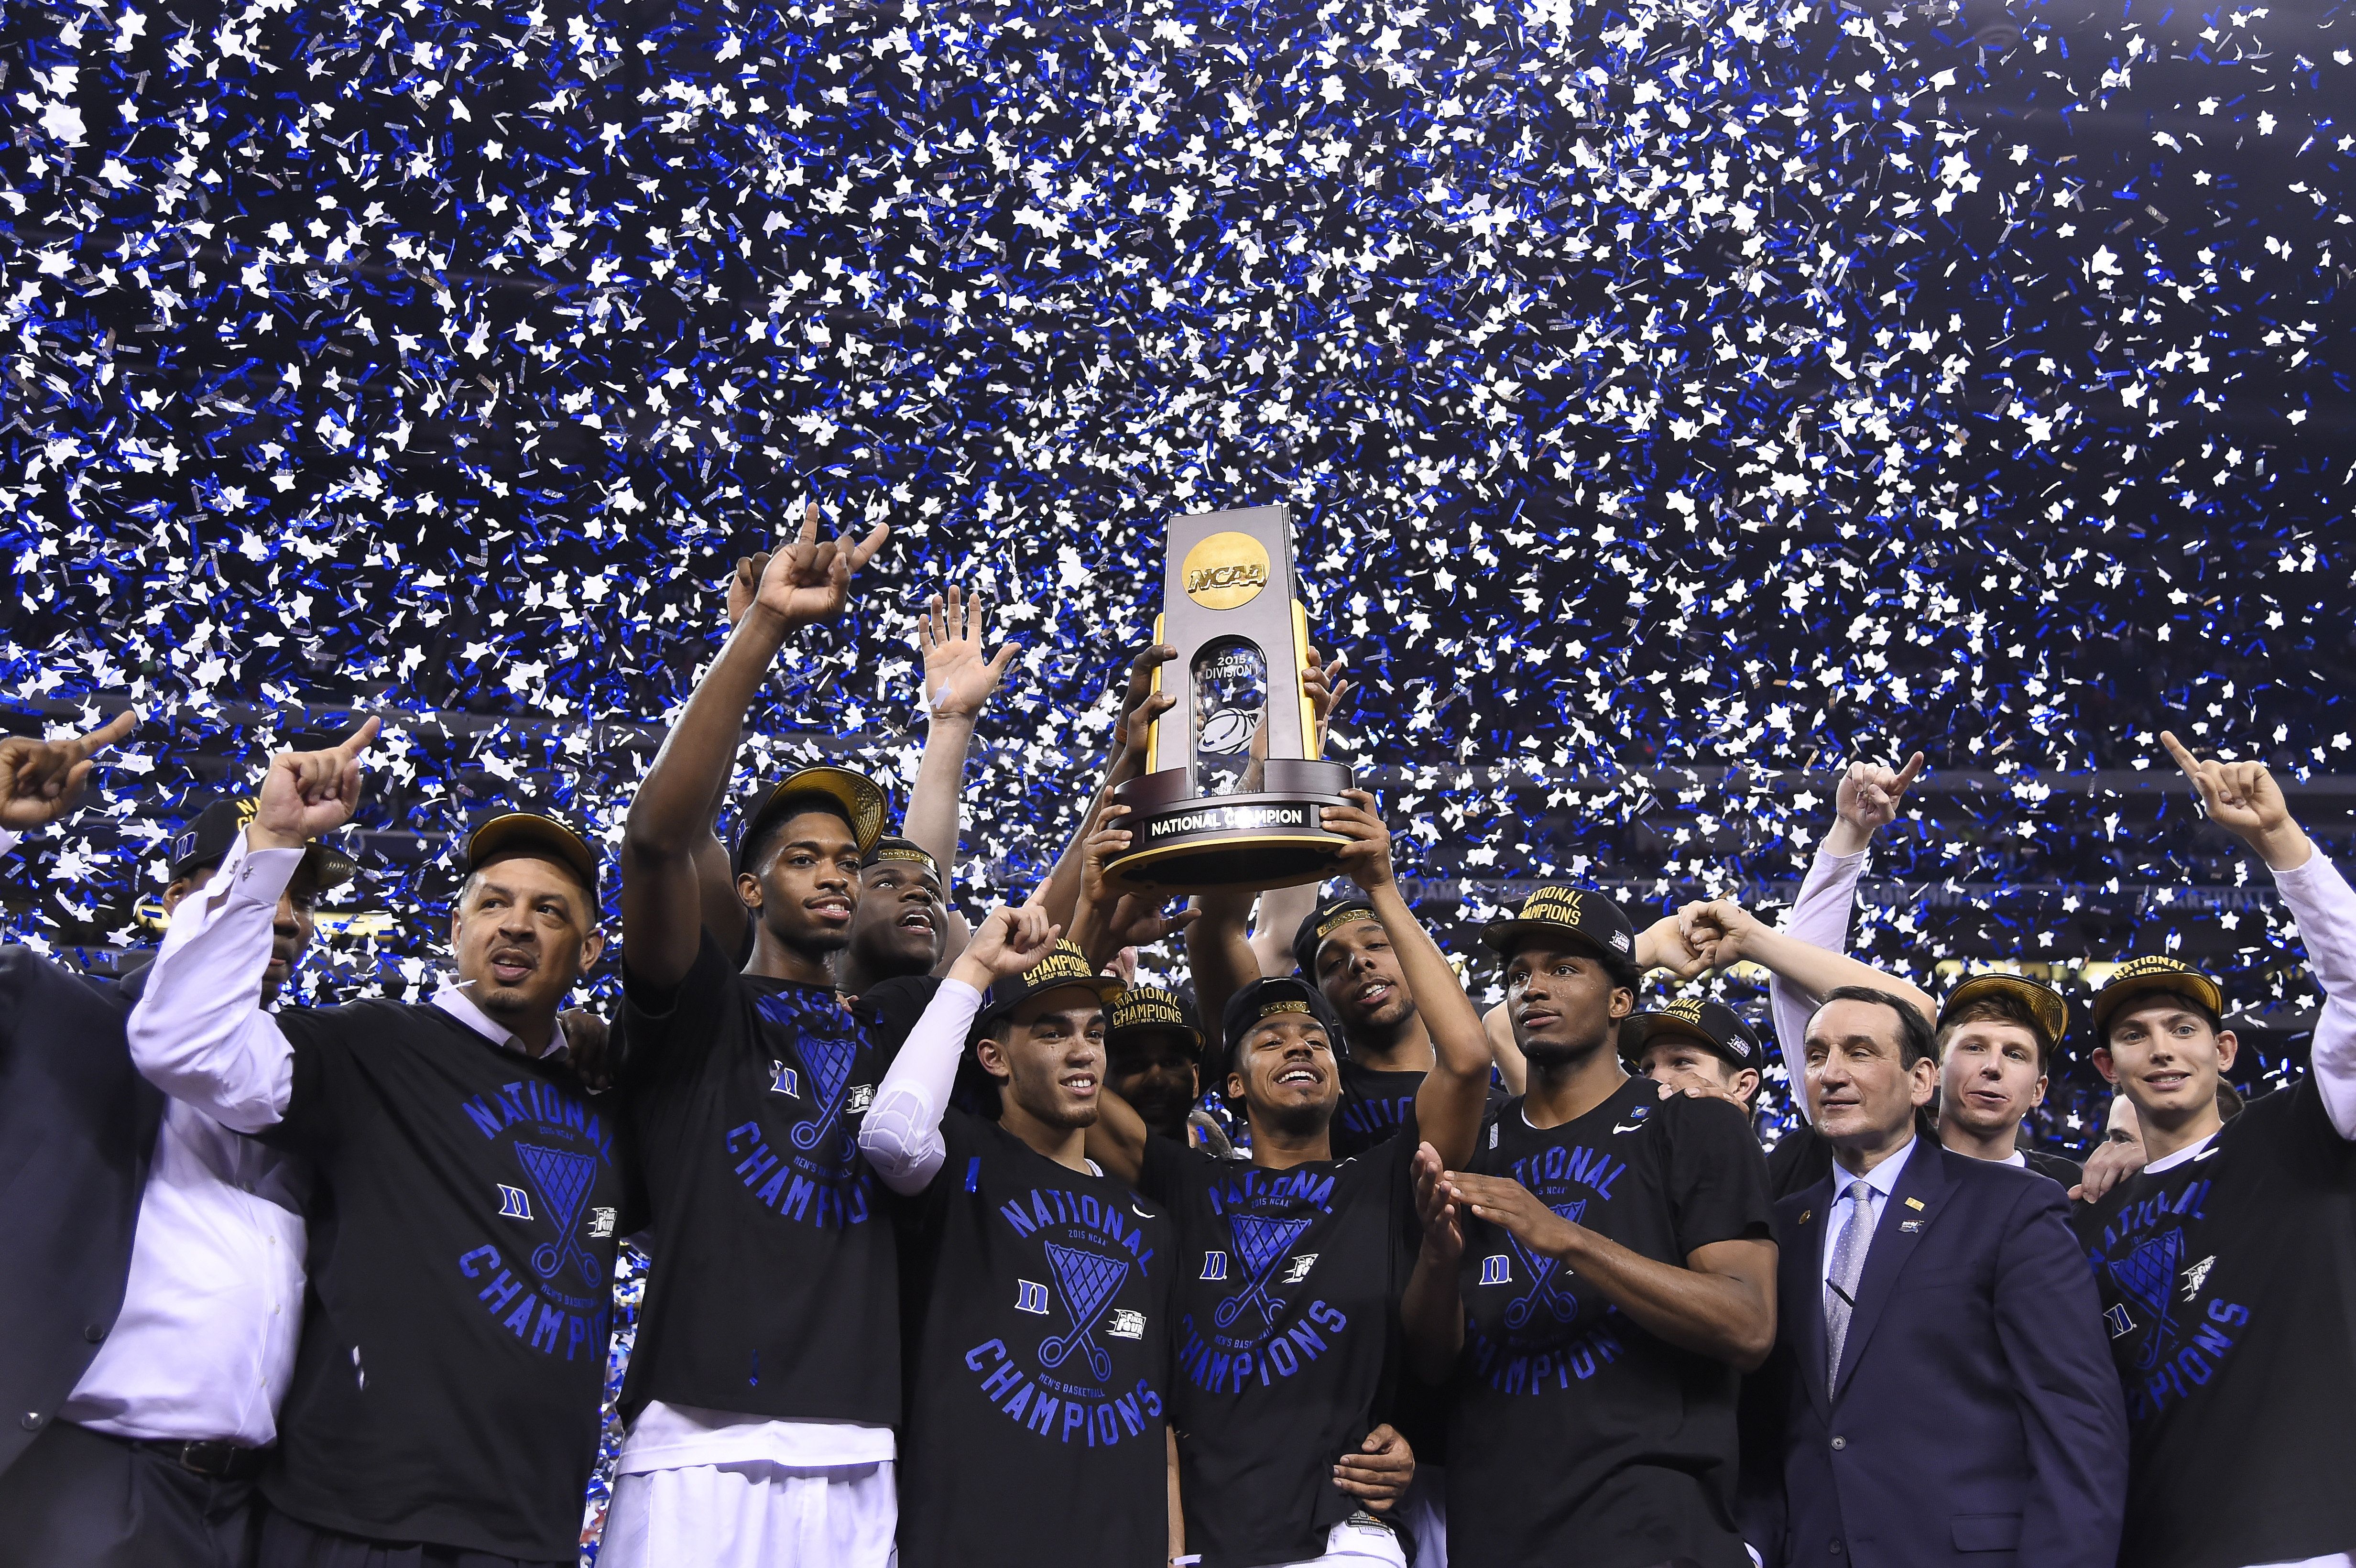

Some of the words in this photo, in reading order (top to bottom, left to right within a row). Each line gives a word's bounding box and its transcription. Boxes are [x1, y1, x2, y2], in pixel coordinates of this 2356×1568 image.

[1188, 564, 1267, 593] NCAA
[1217, 653, 1246, 665] 2015
[1206, 664, 1252, 679] DIVISION
[1152, 813, 1221, 836] NATIONAL
[1224, 809, 1302, 827] CAMPION
[1027, 978, 1039, 987] 2015
[1114, 987, 1179, 1010] NATIONAL
[1113, 1003, 1182, 1025] CHAMPIONS
[462, 1080, 613, 1166] NATIONAL
[726, 1121, 873, 1230] CHAMPIO
[794, 1155, 817, 1173] MEN'S
[1510, 1145, 1626, 1201] TIONAL
[1208, 1170, 1336, 1215] NATIONA
[1269, 1198, 1288, 1208] NCAA
[1000, 1188, 1155, 1277] NATIONAL
[1068, 1229, 1086, 1239] 2015
[1088, 1232, 1106, 1247] NCAA
[459, 1244, 610, 1362] CHAMPIO
[1116, 1318, 1143, 1334] FOUR
[1127, 1313, 1143, 1325] FINAL
[965, 1338, 1163, 1447] CHAMPIONS
[1038, 1372, 1061, 1391] MEN'S
[1063, 1383, 1105, 1398] BASKETBALL
